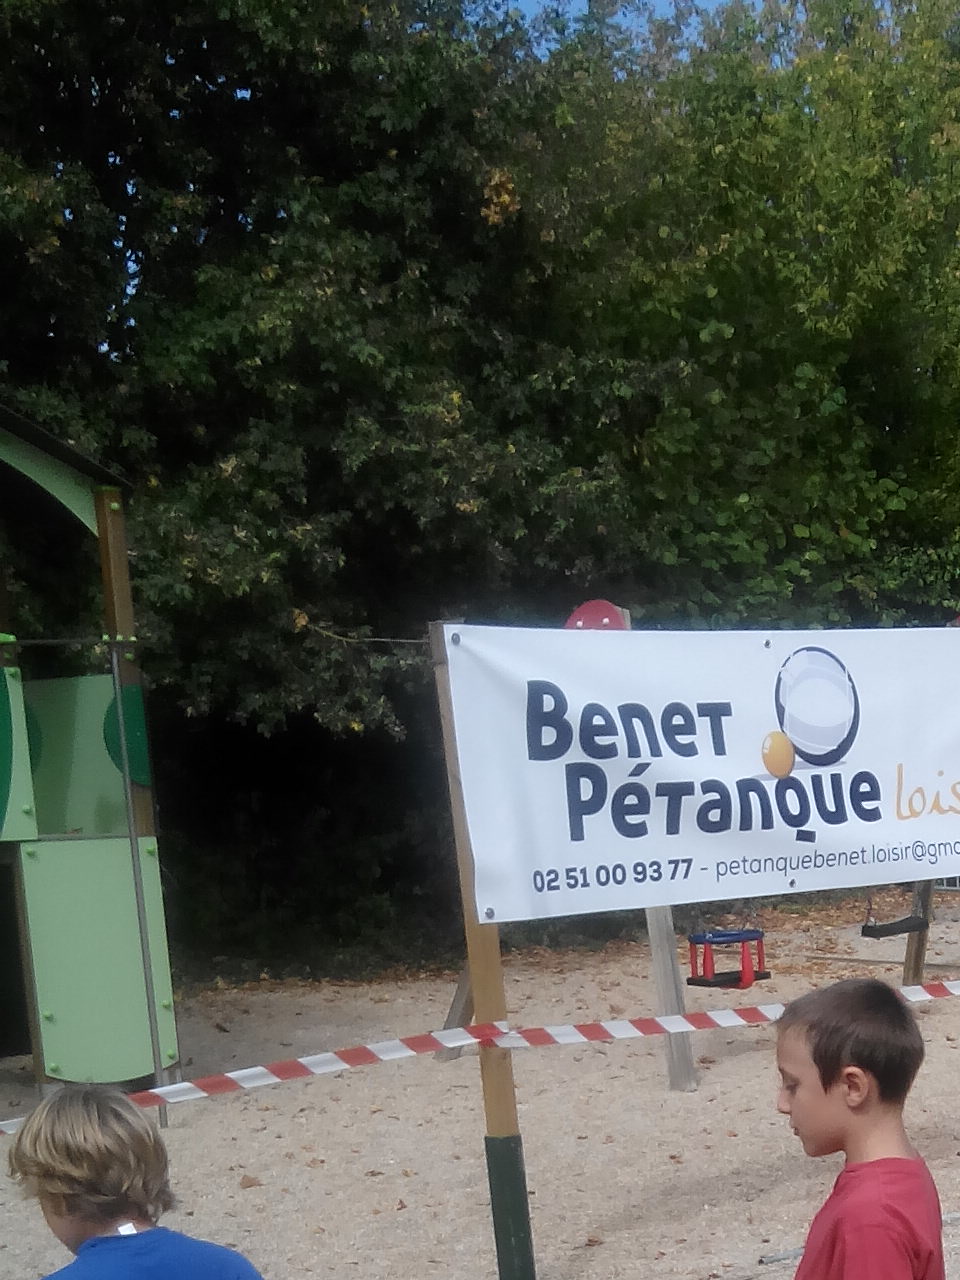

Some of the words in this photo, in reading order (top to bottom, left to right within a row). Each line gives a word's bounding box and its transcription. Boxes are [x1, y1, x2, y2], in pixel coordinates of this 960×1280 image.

[533, 869, 561, 893] 02
[565, 867, 590, 889] 51
[596, 863, 627, 887] 00
[633, 861, 663, 883] 93
[667, 858, 693, 880] 77
